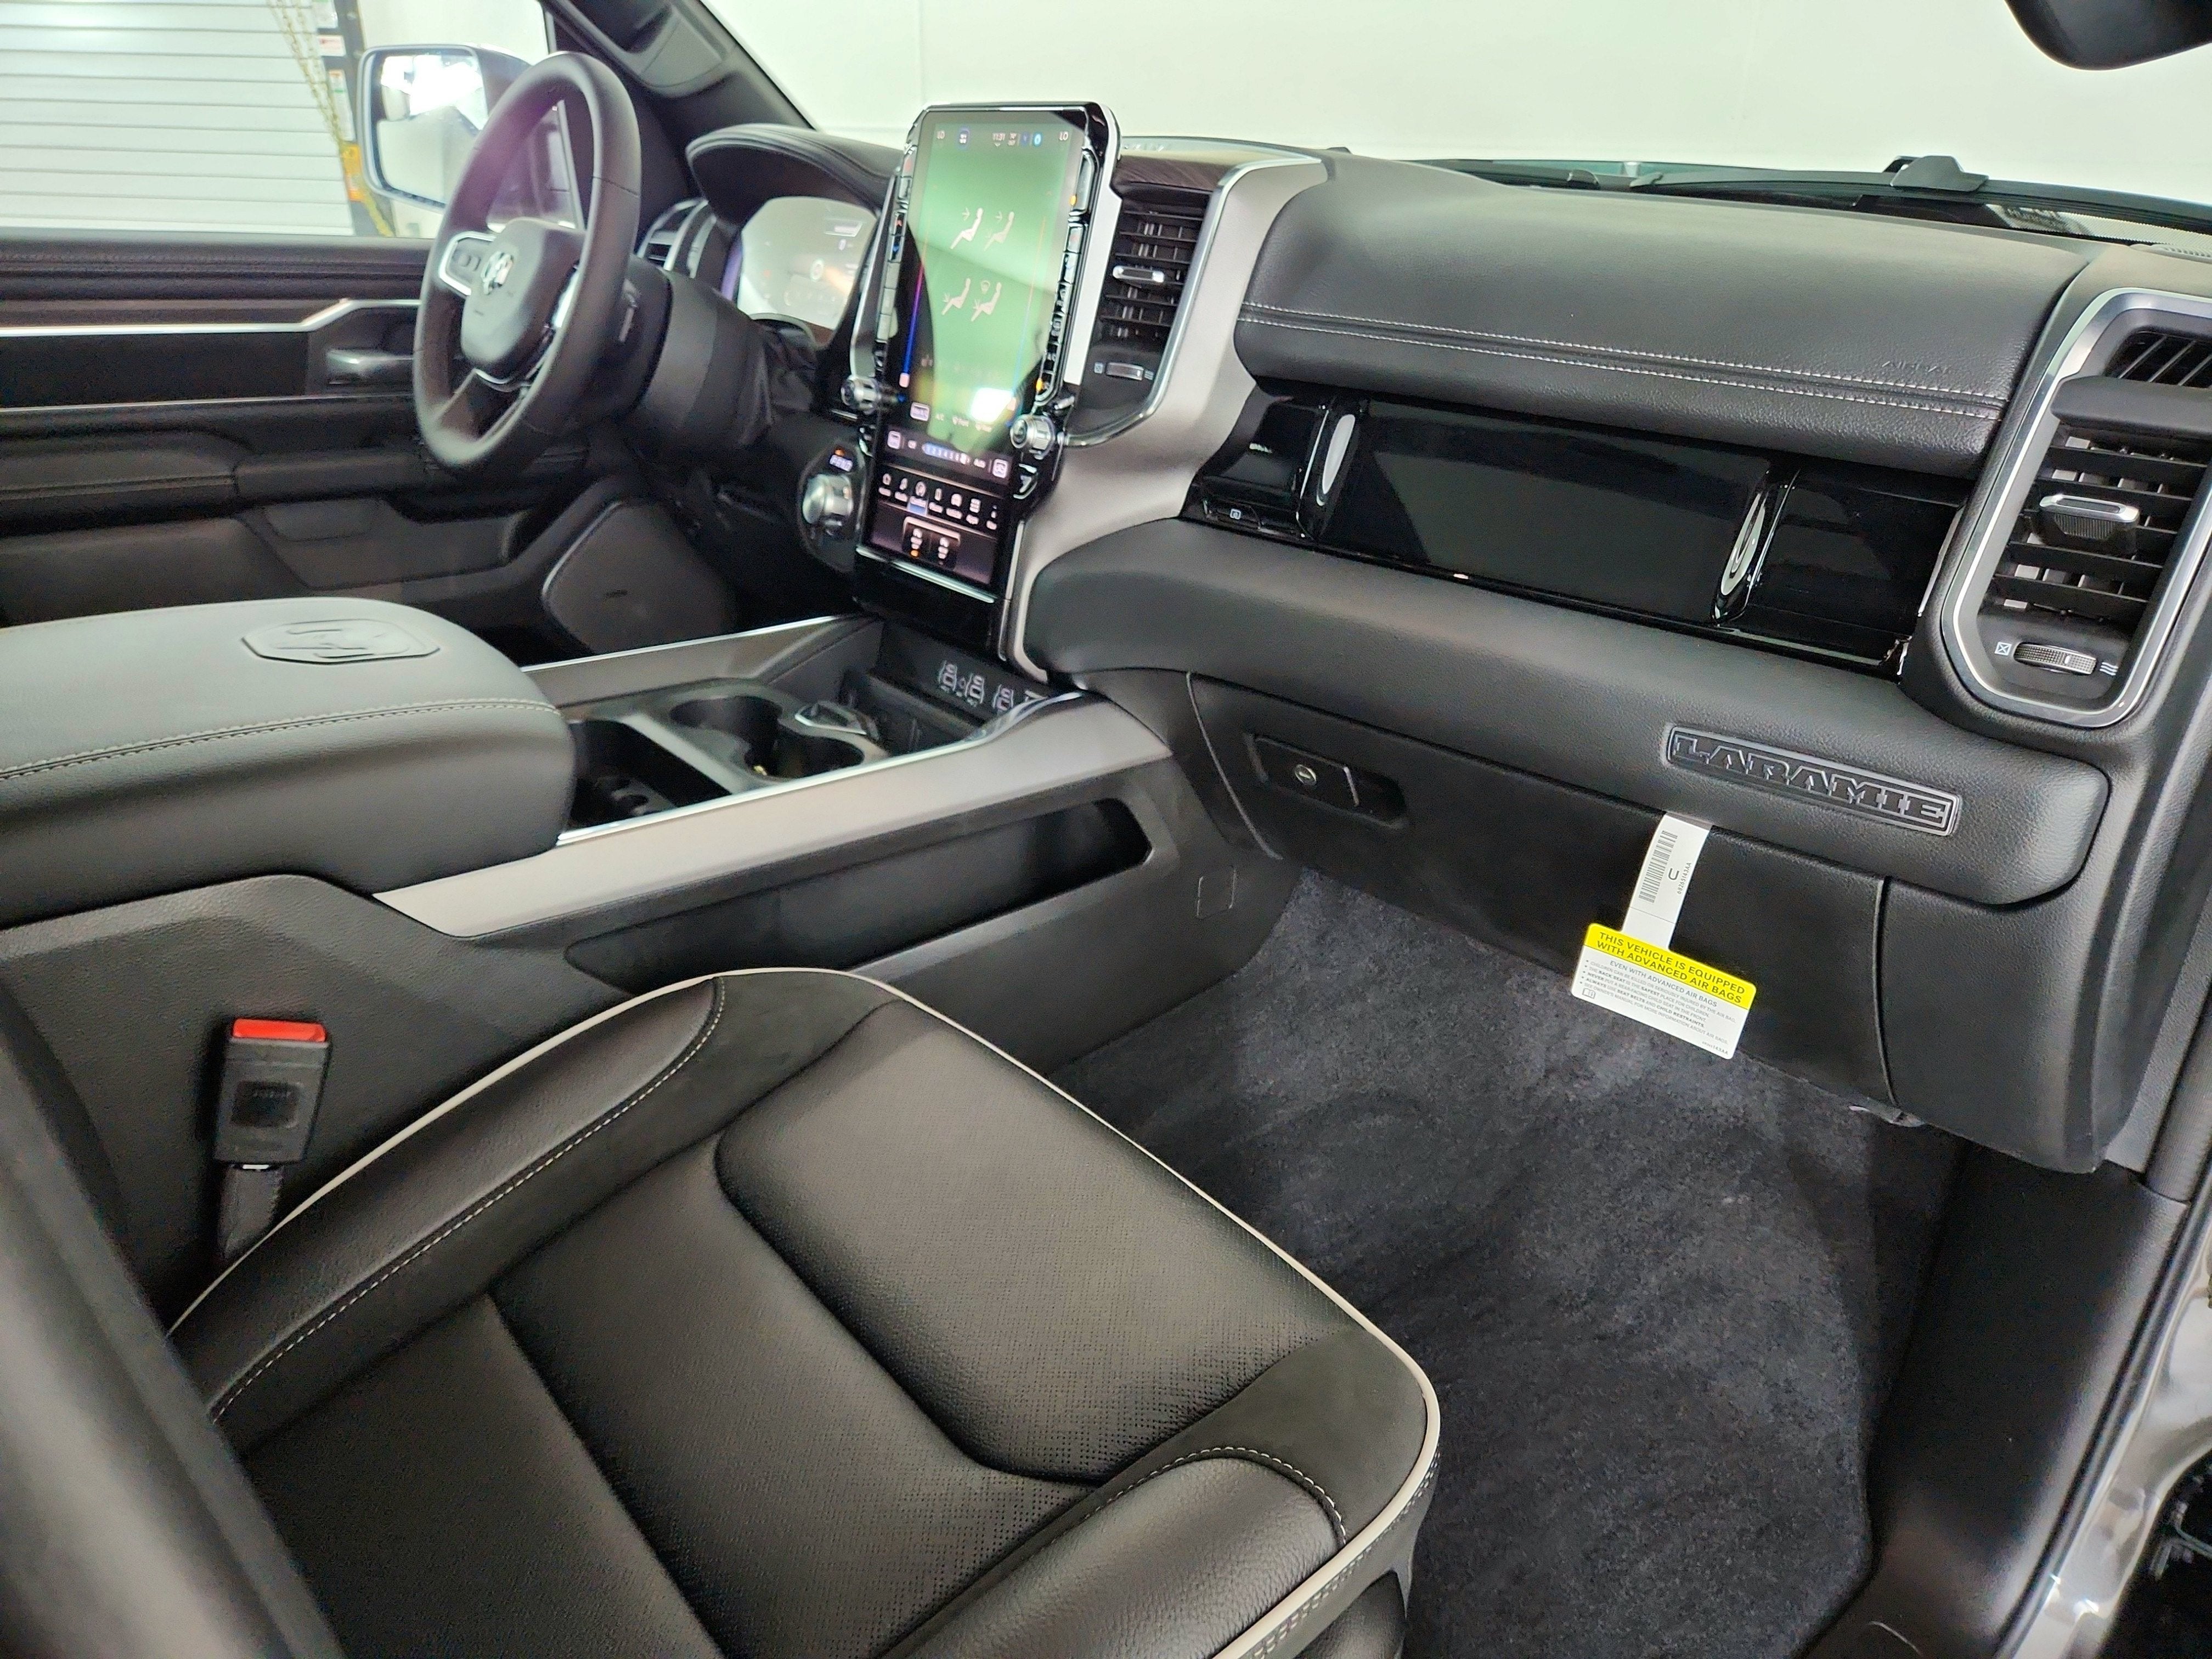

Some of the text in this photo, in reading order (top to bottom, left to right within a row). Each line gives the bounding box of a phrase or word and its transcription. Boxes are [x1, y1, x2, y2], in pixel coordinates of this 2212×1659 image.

[1674, 733, 1951, 828] LARAMIE
[1588, 972, 1604, 981] NEVER
[1596, 941, 1742, 1003] WITH ADVANCED AIR BAGS
[1599, 932, 1746, 995] THIS VEHICLE IS EQUIPPED
[1610, 961, 1717, 1007] EVEN WITH ADVANCED AIR BAGS
[1587, 978, 1606, 988] ALWAYS
[1630, 995, 1645, 1003] BELTS
[1657, 1005, 1672, 1014] CHILD
[1641, 986, 1660, 996] SAFEST
[1660, 994, 1674, 1002] PLACE
[1658, 1012, 1689, 1027] INFORMATION
[1690, 1025, 1706, 1034] ABOUT
